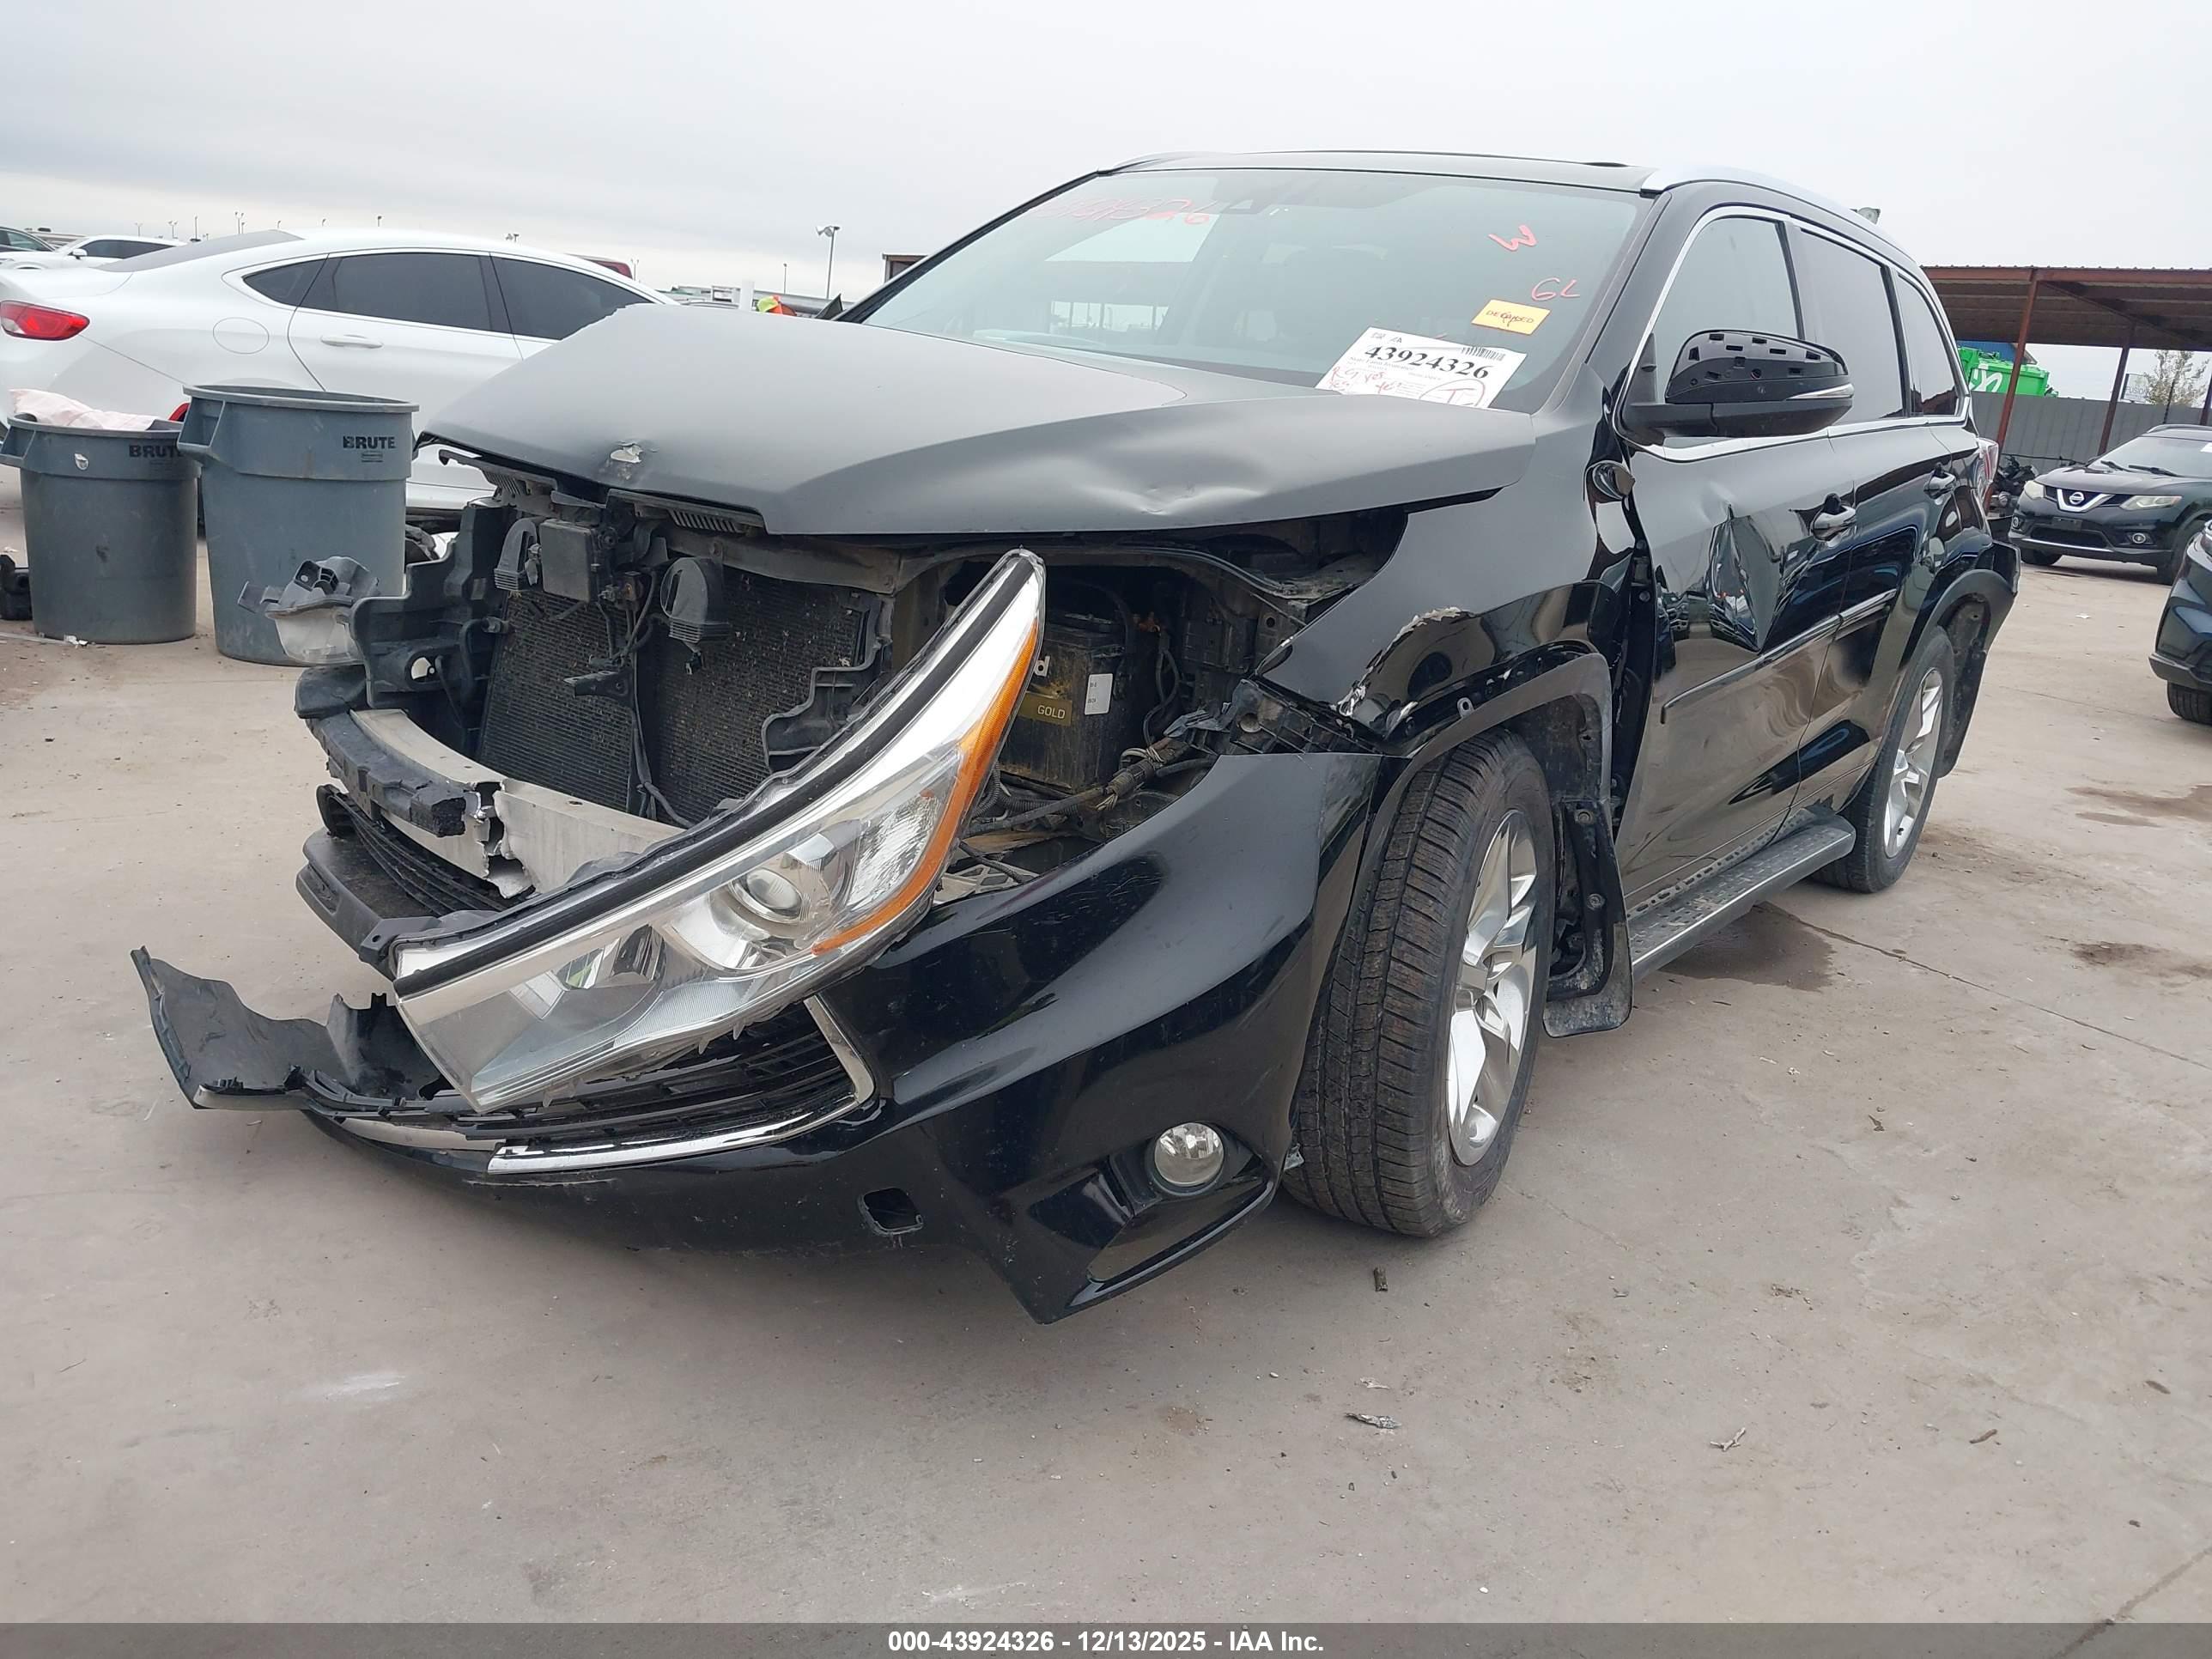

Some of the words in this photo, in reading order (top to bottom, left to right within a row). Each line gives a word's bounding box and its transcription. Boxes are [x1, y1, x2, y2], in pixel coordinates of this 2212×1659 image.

[1364, 345, 1493, 380] 43924326
[343, 435, 397, 449] BRUTE
[1037, 704, 1066, 720] GOLD
